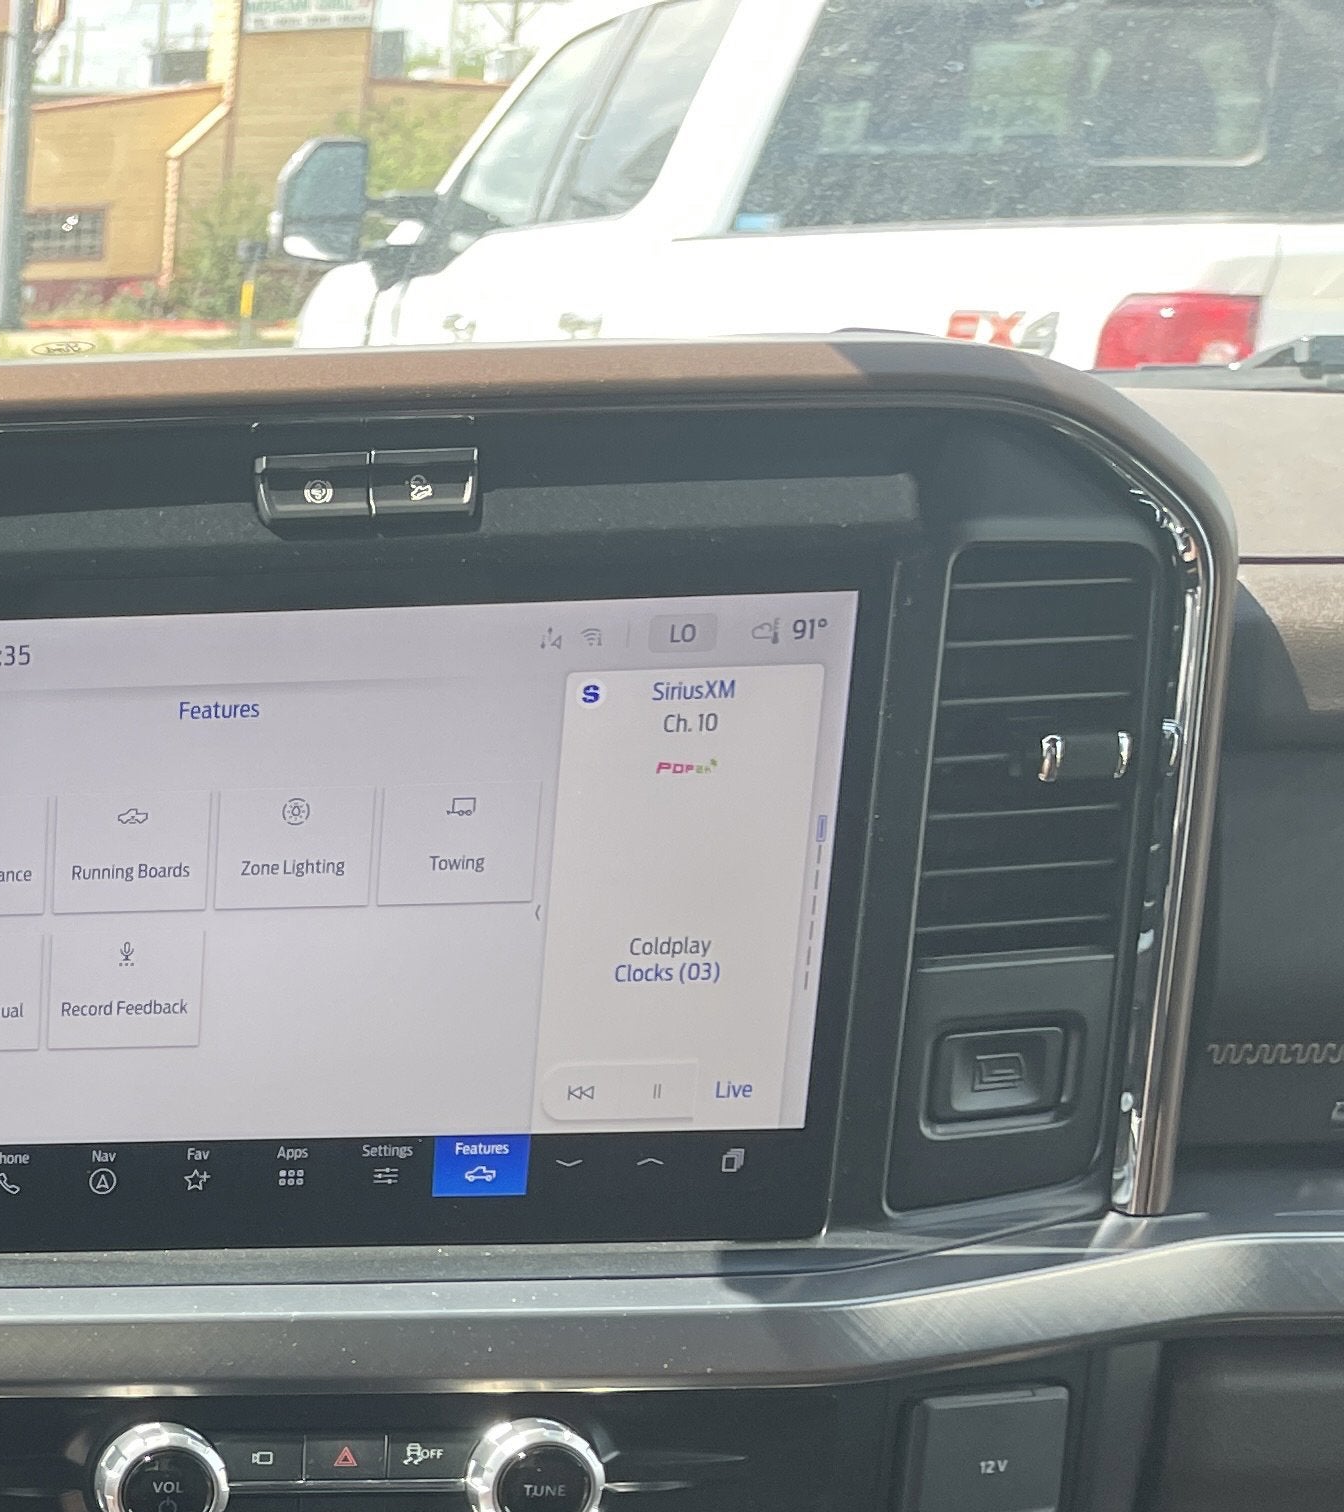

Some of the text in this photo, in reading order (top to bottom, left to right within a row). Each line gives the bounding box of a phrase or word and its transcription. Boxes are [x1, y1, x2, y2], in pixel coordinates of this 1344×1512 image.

[670, 618, 828, 643] LO 91°
[652, 680, 736, 701] SiriusXM
[179, 702, 260, 720] Features
[663, 713, 718, 733] Ch. 10
[71, 862, 190, 883] Running Boards
[241, 858, 345, 878] Zone Lighting
[430, 854, 485, 873] Towing
[629, 936, 711, 958] Coldplay
[614, 962, 721, 985] Clocks (03)
[61, 998, 188, 1018] Record Feedback
[715, 1080, 753, 1100] Live
[92, 1149, 116, 1163] Nav
[187, 1147, 210, 1162] Fav
[277, 1146, 308, 1162] Apps
[362, 1143, 413, 1160] Settings
[455, 1141, 509, 1156] Features
[420, 1448, 444, 1461] OFF
[152, 1480, 184, 1495] VOL
[523, 1484, 566, 1498] TUNE
